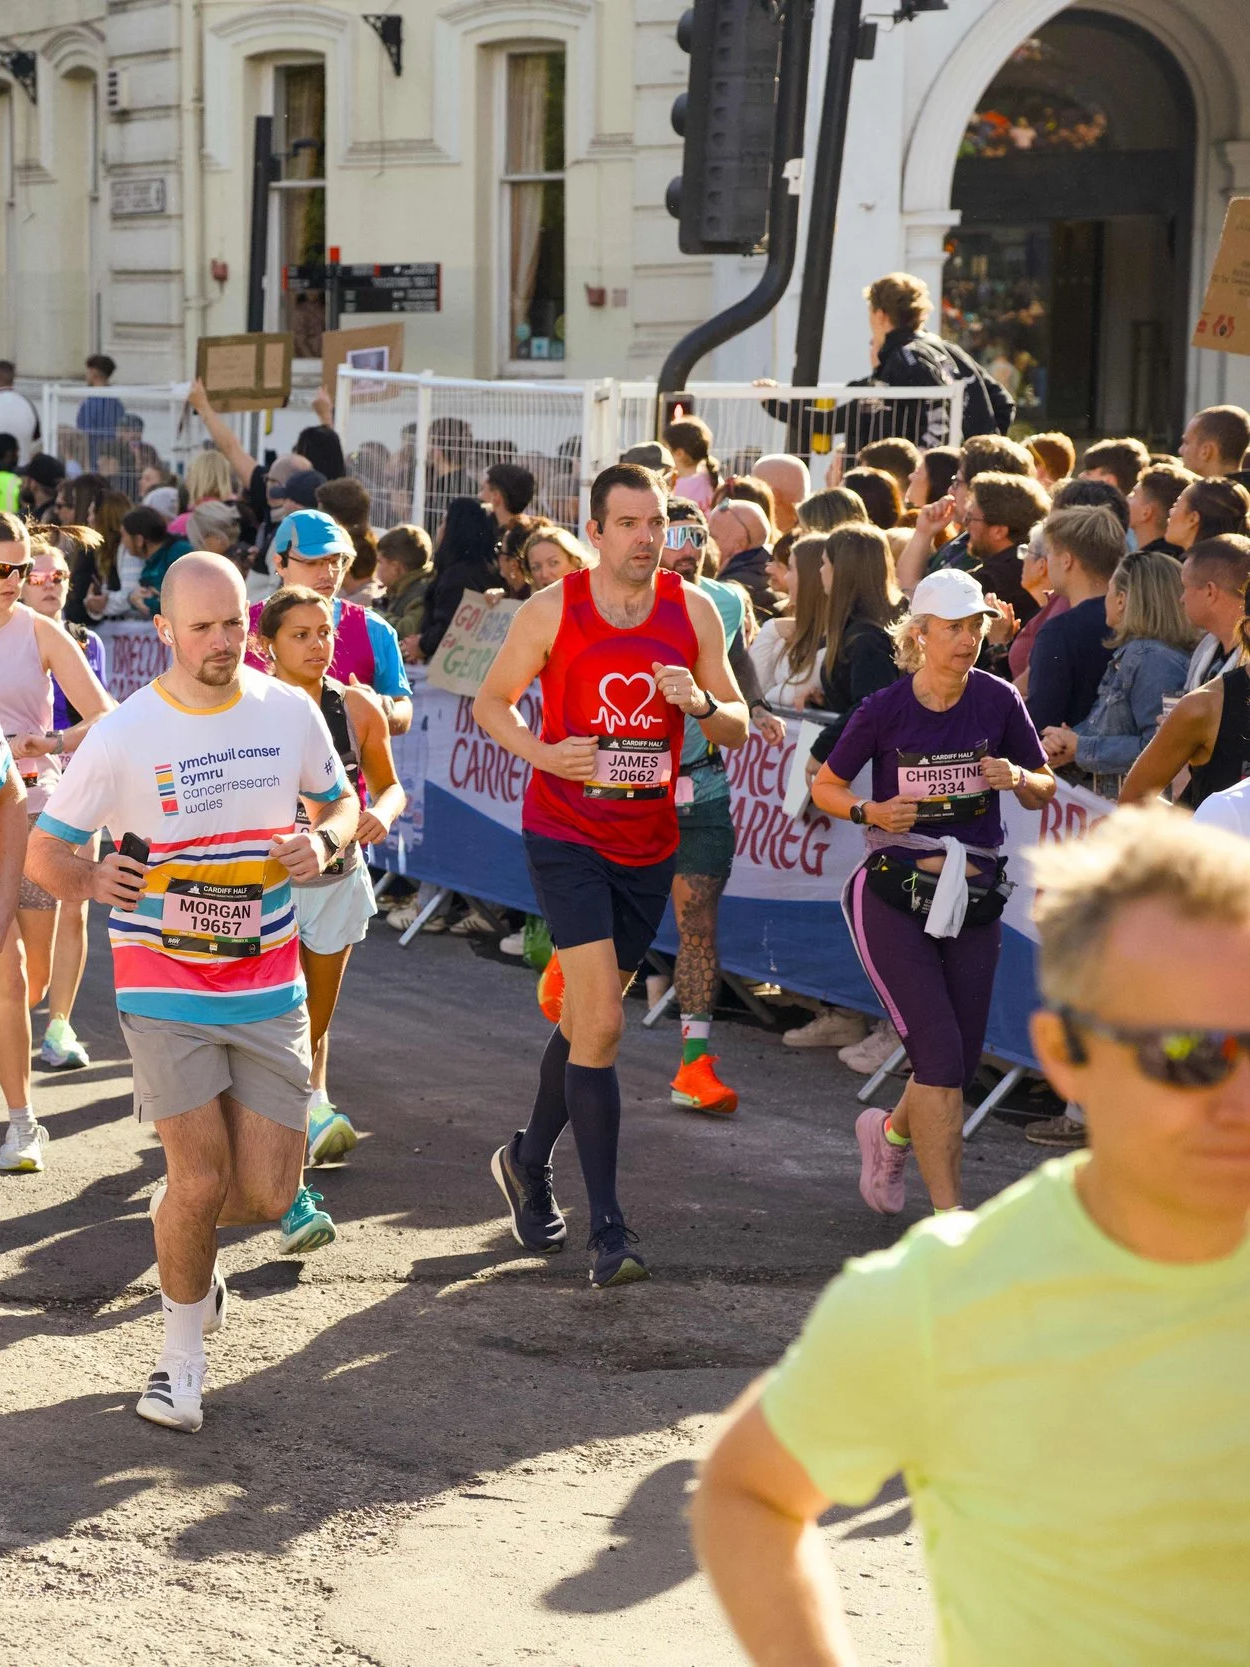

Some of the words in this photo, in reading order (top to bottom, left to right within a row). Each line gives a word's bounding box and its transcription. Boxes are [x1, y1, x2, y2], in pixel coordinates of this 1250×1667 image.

[622, 739, 648, 747] CARDIFF
[178, 748, 236, 773] ymchwil
[238, 746, 281, 759] canser
[608, 754, 659, 768] JAMES
[931, 753, 957, 761] CARDIFF
[180, 767, 224, 786] cymru
[450, 738, 533, 803] CARRE
[610, 768, 655, 783] 20662
[906, 764, 984, 783] CHRISTINE
[183, 781, 227, 800] cancer
[227, 775, 281, 792] research
[928, 781, 965, 796] 2334
[185, 798, 223, 815] wales
[731, 797, 831, 877] ARREG
[203, 885, 232, 894] CARDIFF
[180, 899, 251, 919] MORGAN
[191, 916, 242, 936] 19657
